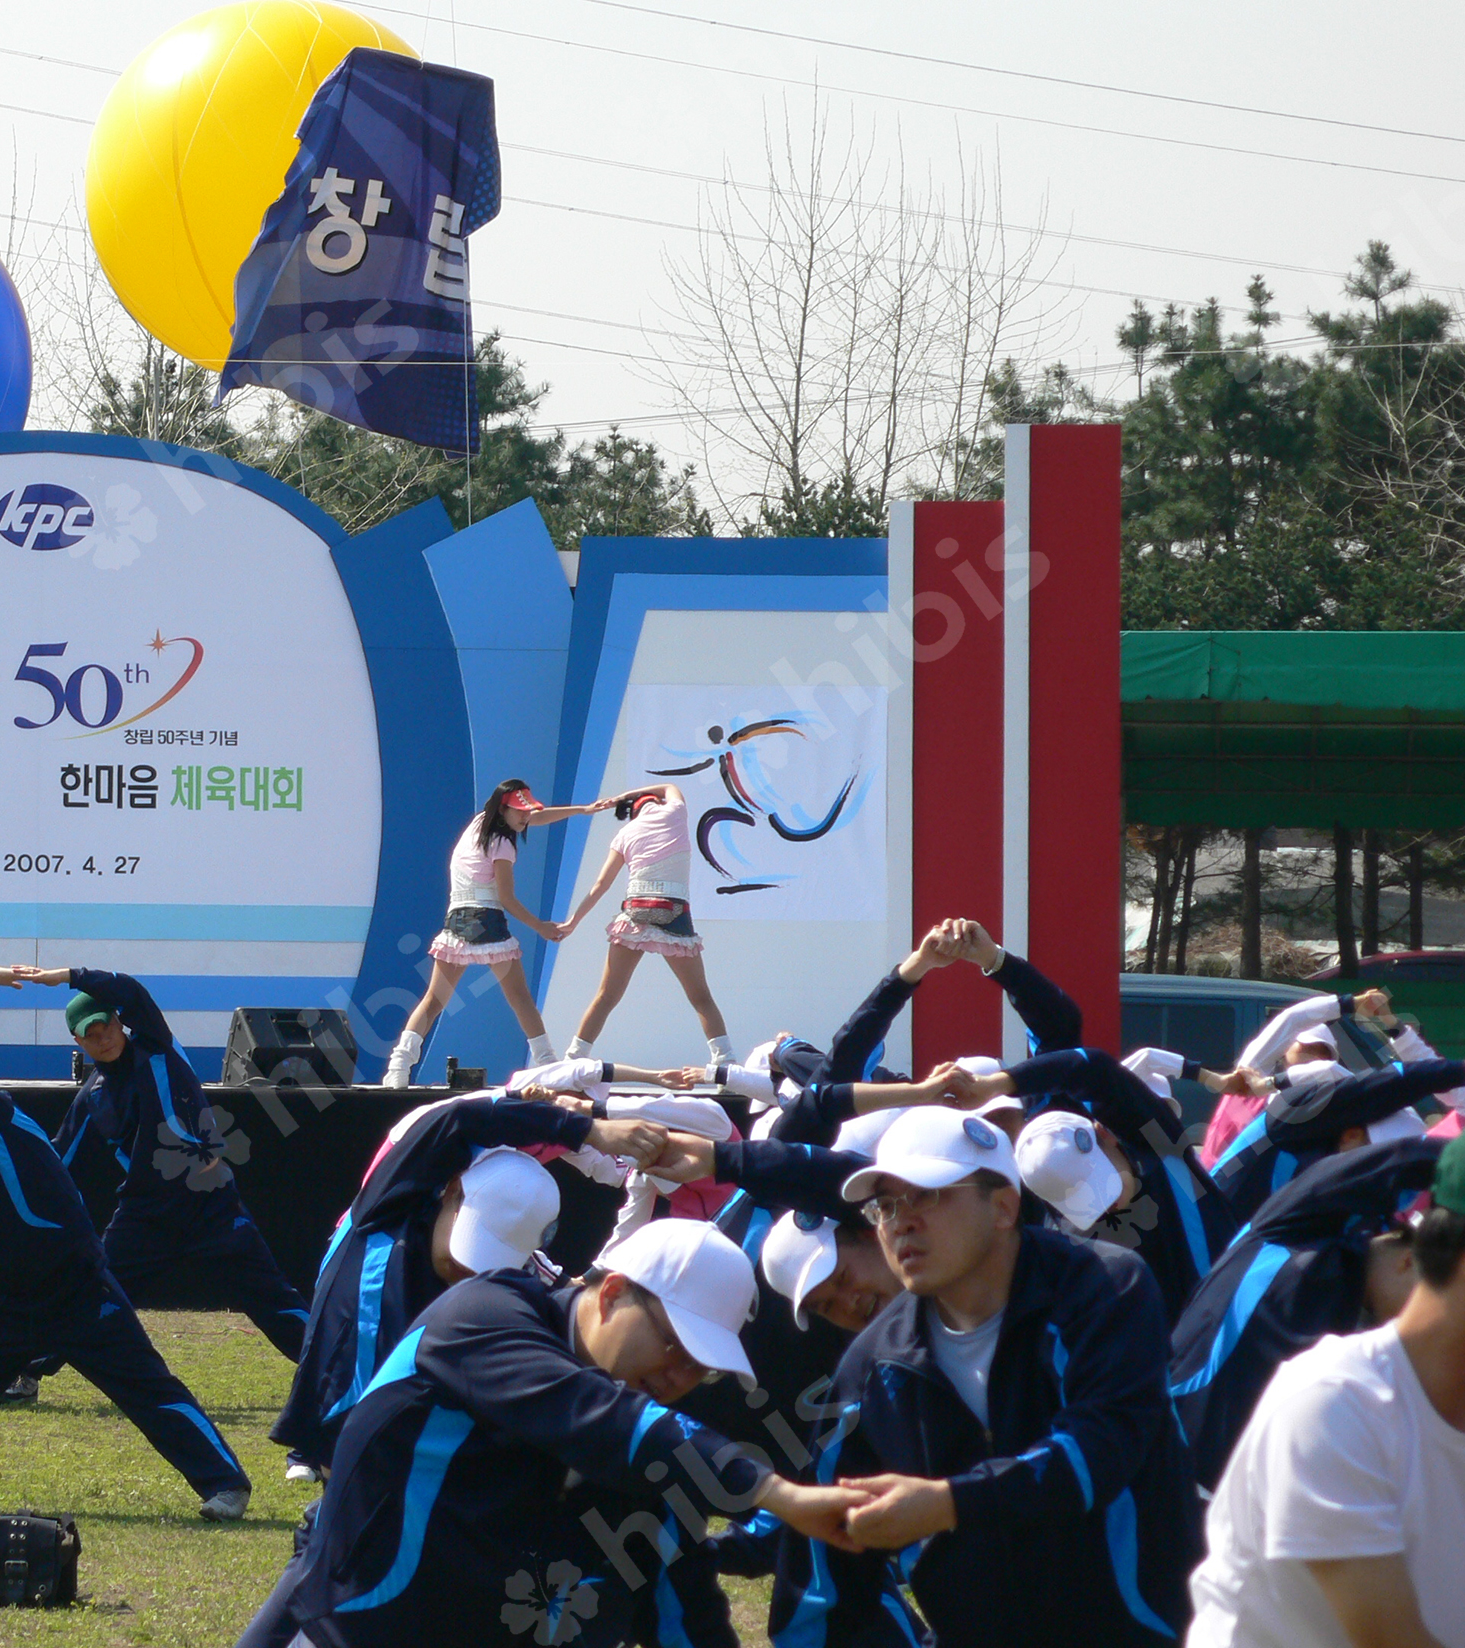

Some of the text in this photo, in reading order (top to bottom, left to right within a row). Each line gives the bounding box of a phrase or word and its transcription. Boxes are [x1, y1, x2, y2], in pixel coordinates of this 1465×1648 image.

[123, 729, 239, 747] 창립 50주년 기념
[59, 763, 303, 812] 한마음 체육대회
[3, 853, 72, 876] 2007.
[82, 855, 103, 876] 4.
[114, 855, 141, 875] 27
